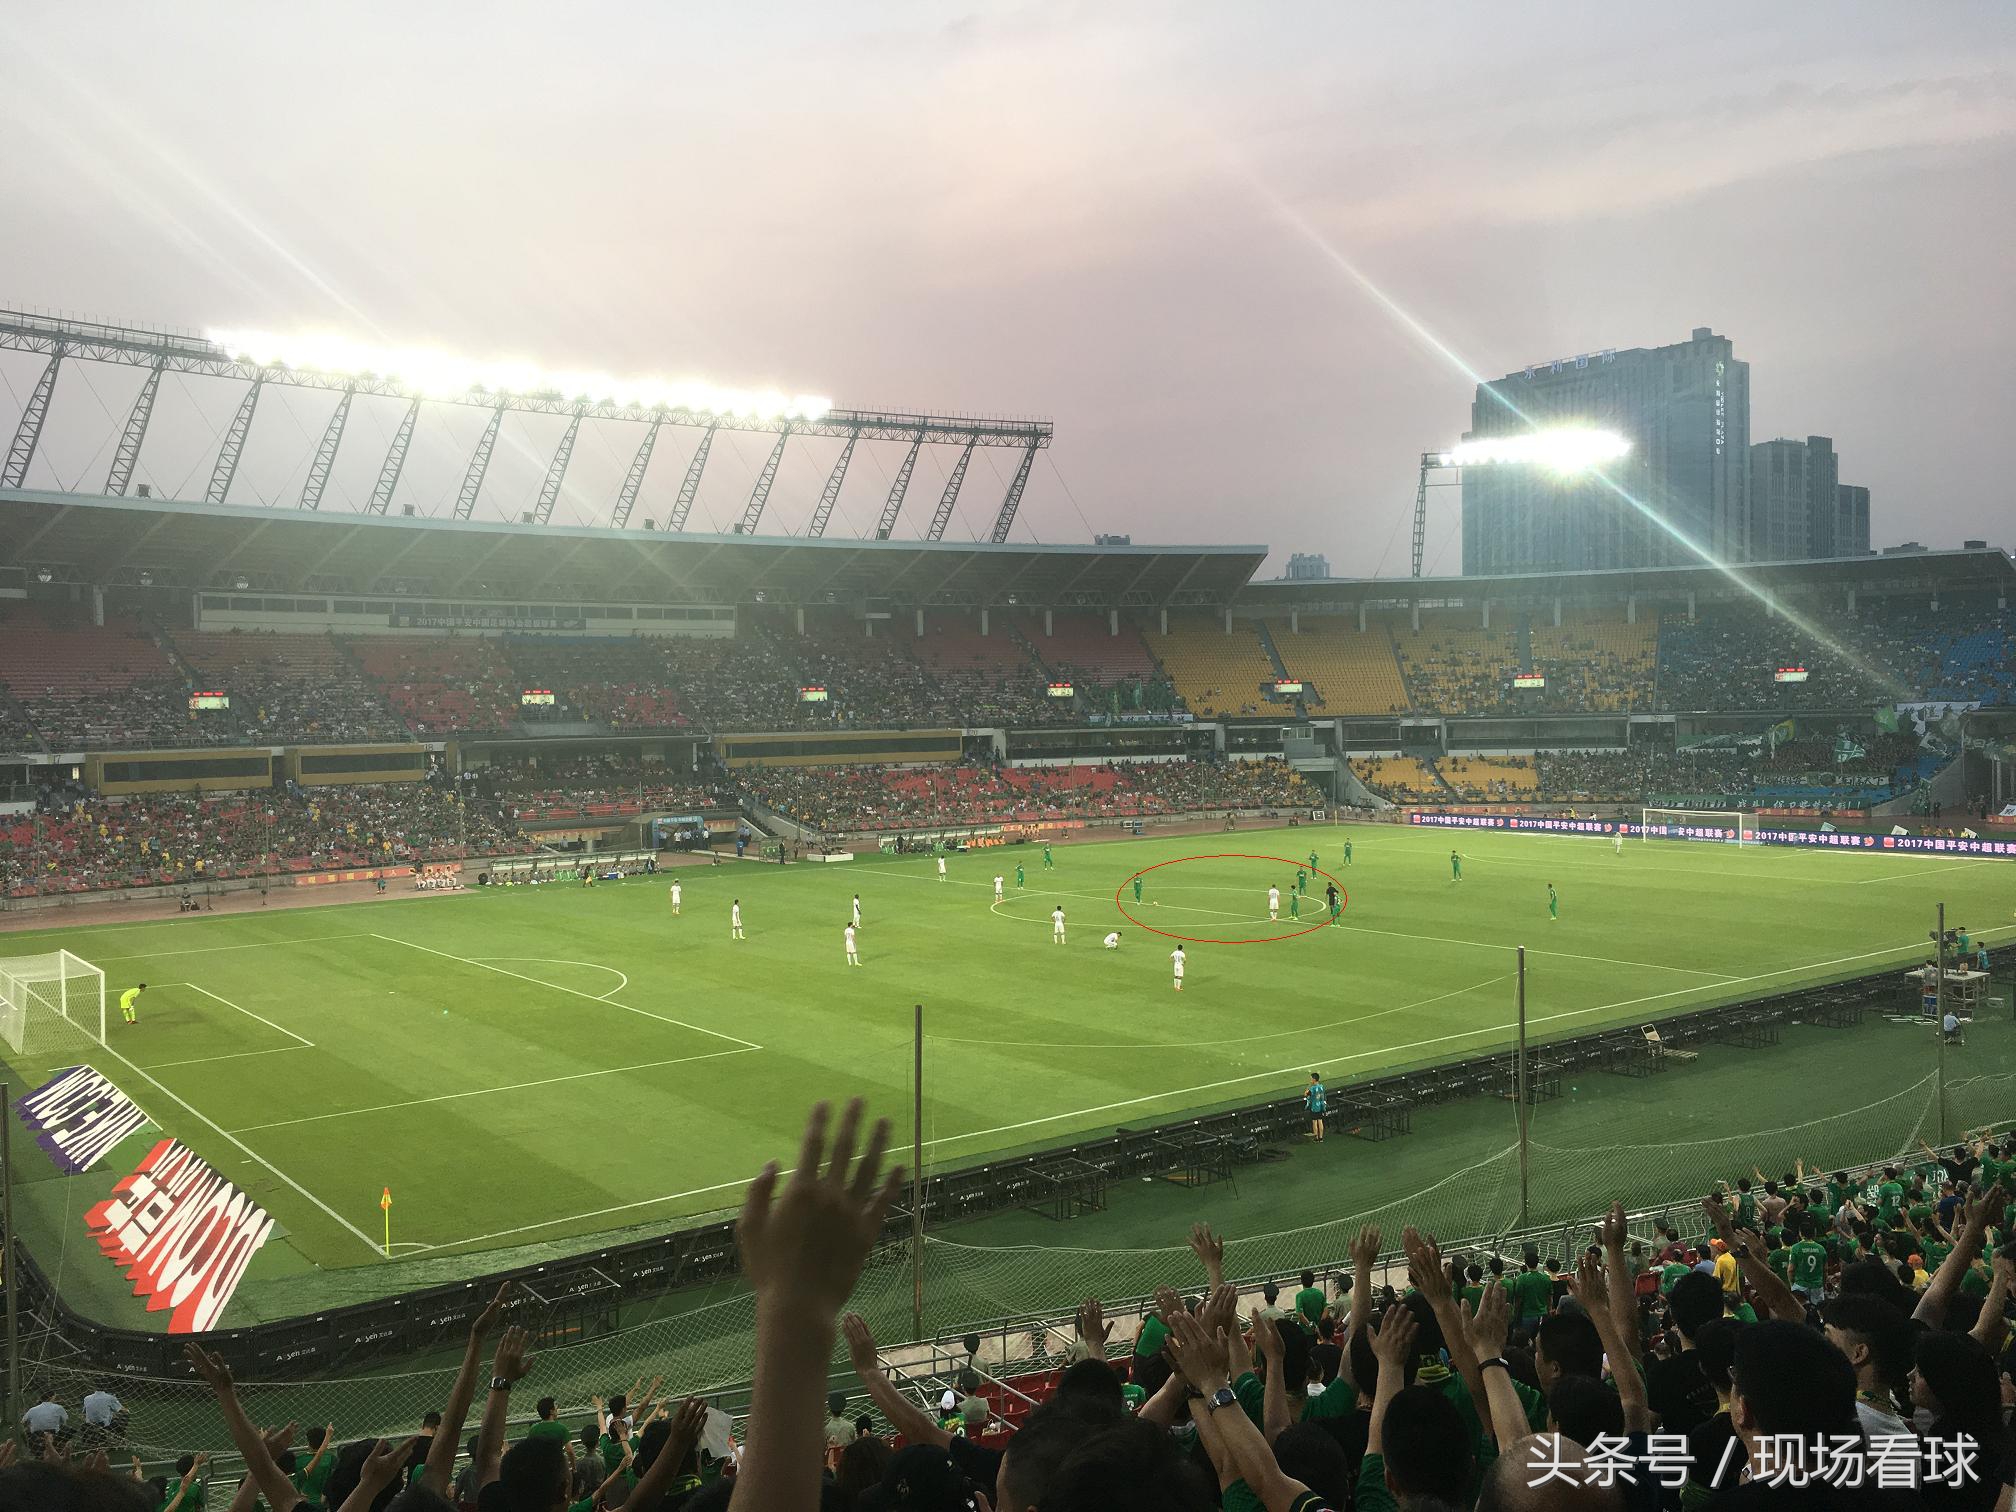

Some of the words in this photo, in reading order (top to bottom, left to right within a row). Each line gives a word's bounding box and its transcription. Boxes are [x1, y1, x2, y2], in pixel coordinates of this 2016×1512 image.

[1519, 819, 1602, 832] 2017中国平安中超联赛
[1630, 825, 1723, 838] 2017中国安中超联赛
[1755, 832, 1861, 846] 2017中国平安中超联赛
[1807, 1255, 1817, 1273] 9
